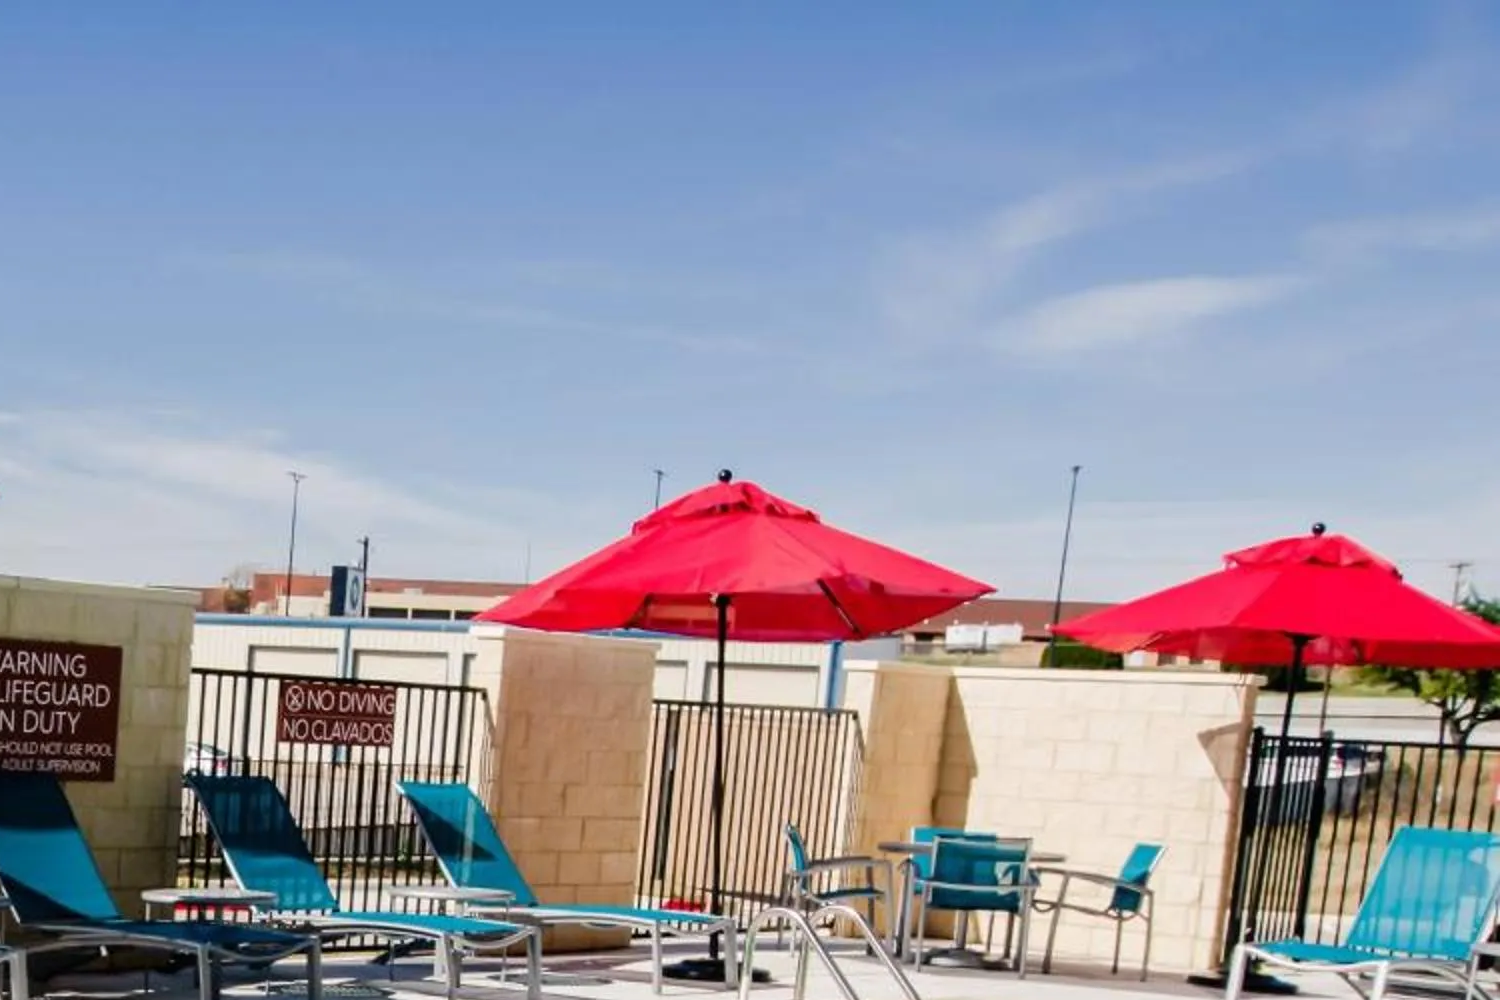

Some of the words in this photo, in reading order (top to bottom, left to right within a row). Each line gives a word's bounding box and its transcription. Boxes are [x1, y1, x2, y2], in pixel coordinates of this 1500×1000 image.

[307, 689, 335, 711] NO
[339, 691, 395, 715] DIVING
[23, 708, 81, 735] DUTY
[282, 718, 309, 740] NO
[311, 719, 394, 744] CLAVADOS
[40, 741, 63, 756] NOT
[63, 742, 84, 758] USE
[85, 742, 114, 758] POOL
[1, 758, 35, 772] ADULT
[35, 758, 102, 775] SUPERVISION
